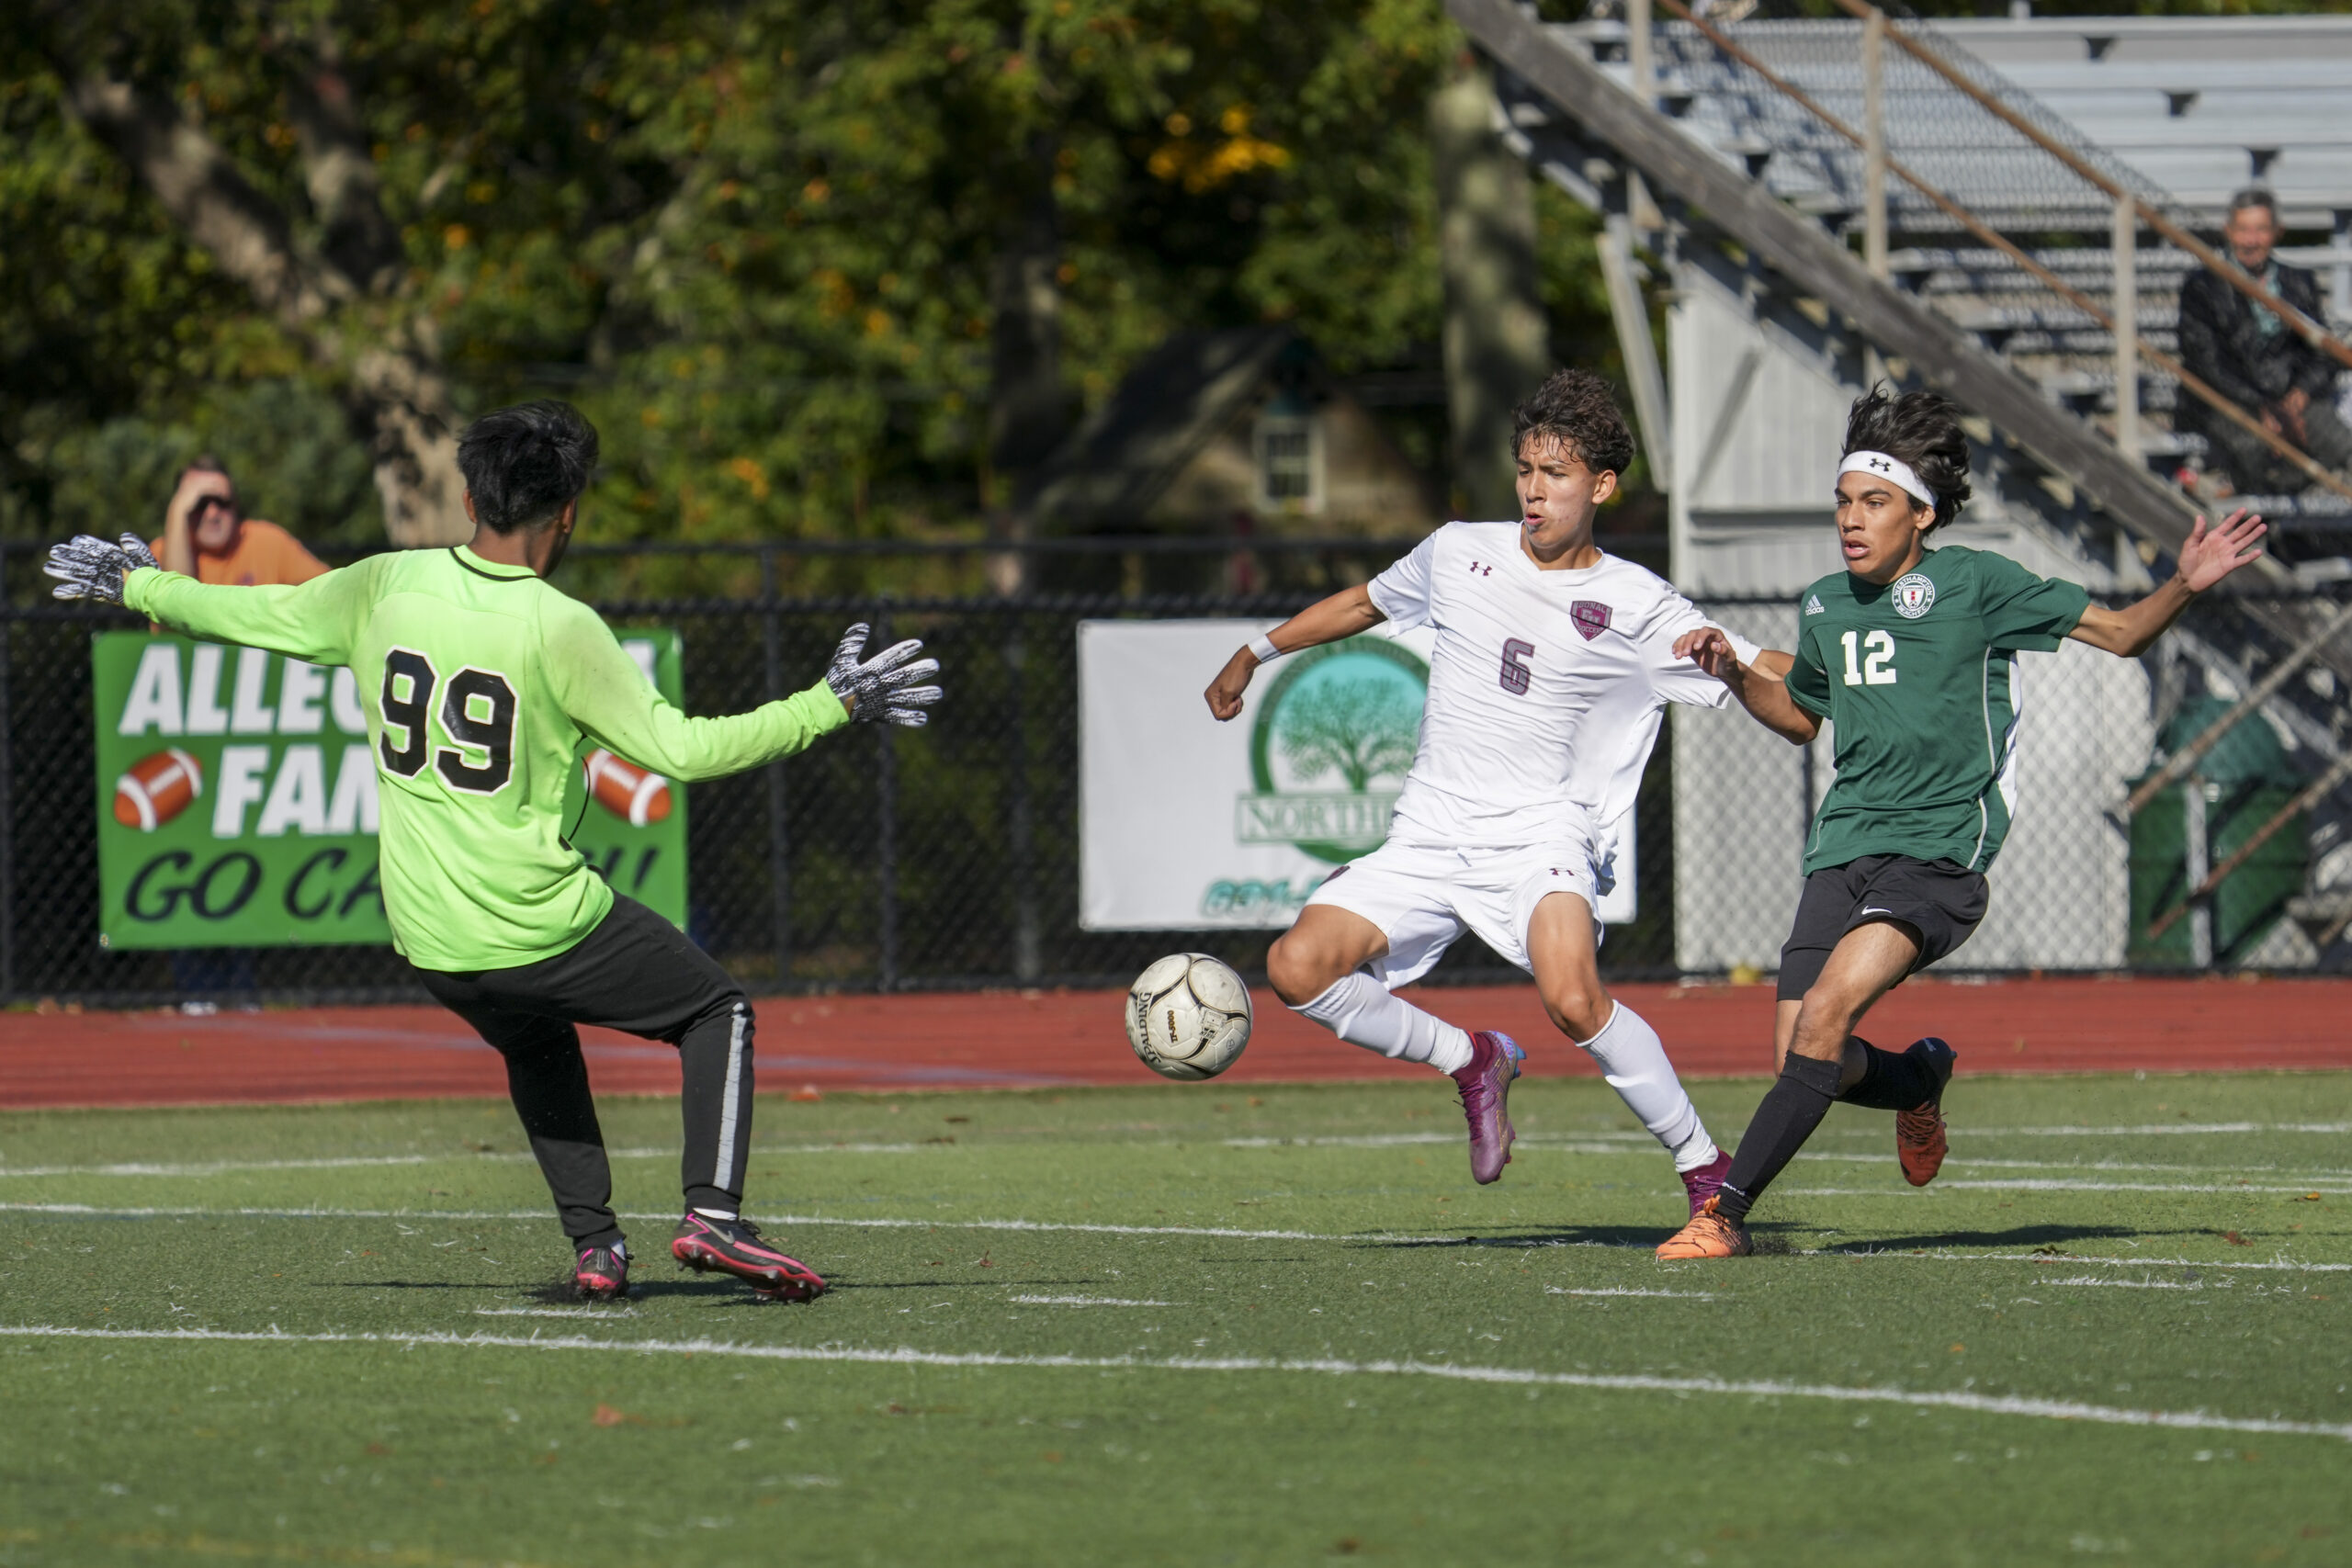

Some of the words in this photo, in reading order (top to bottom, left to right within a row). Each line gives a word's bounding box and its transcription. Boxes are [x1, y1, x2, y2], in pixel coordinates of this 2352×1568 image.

[1805, 606, 1825, 616] adidas
[1894, 575, 1933, 596] WESTHAMPTON
[1499, 637, 1535, 696] 6
[1841, 630, 1897, 686] 12
[378, 645, 520, 796] 99
[125, 851, 263, 921] GO
[1138, 992, 1161, 1064] SPALDING
